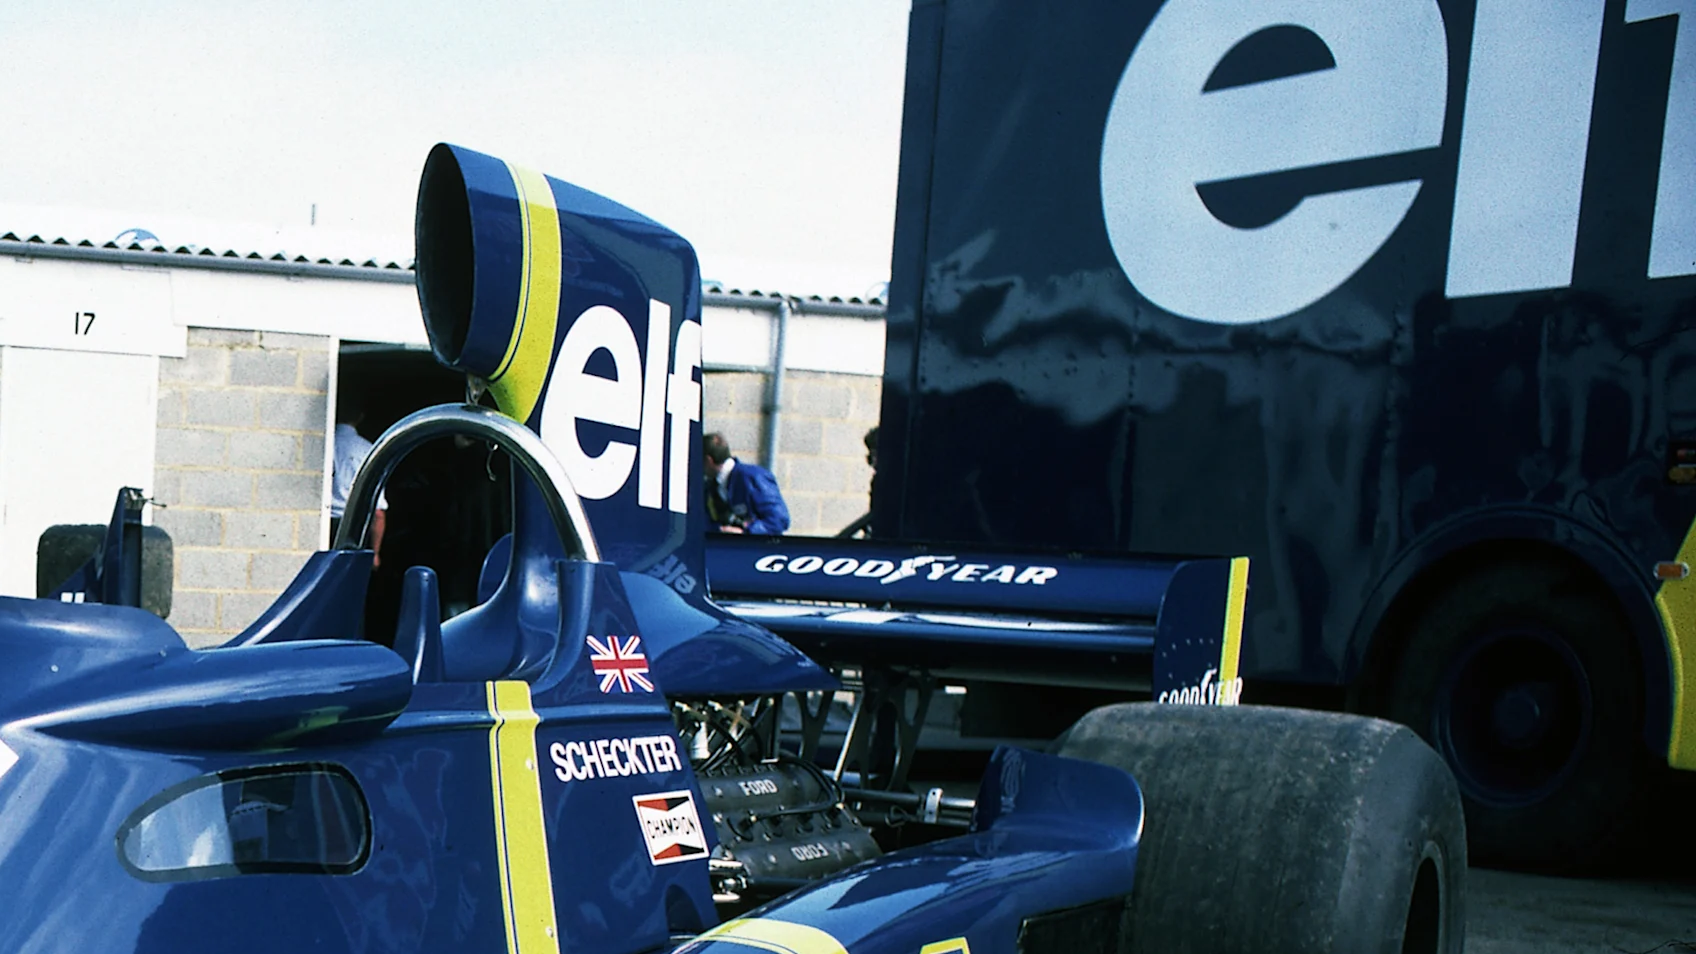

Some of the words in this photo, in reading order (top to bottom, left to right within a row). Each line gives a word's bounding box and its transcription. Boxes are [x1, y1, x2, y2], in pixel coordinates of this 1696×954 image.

[1100, 0, 1696, 325] el
[75, 312, 96, 335] 17
[540, 298, 702, 514] elf
[755, 554, 1058, 585] GOODYEAR
[550, 735, 683, 783] SCHECKTER
[738, 779, 779, 797] FORD
[646, 815, 698, 839] CHAMPION
[791, 842, 829, 861] FORD
